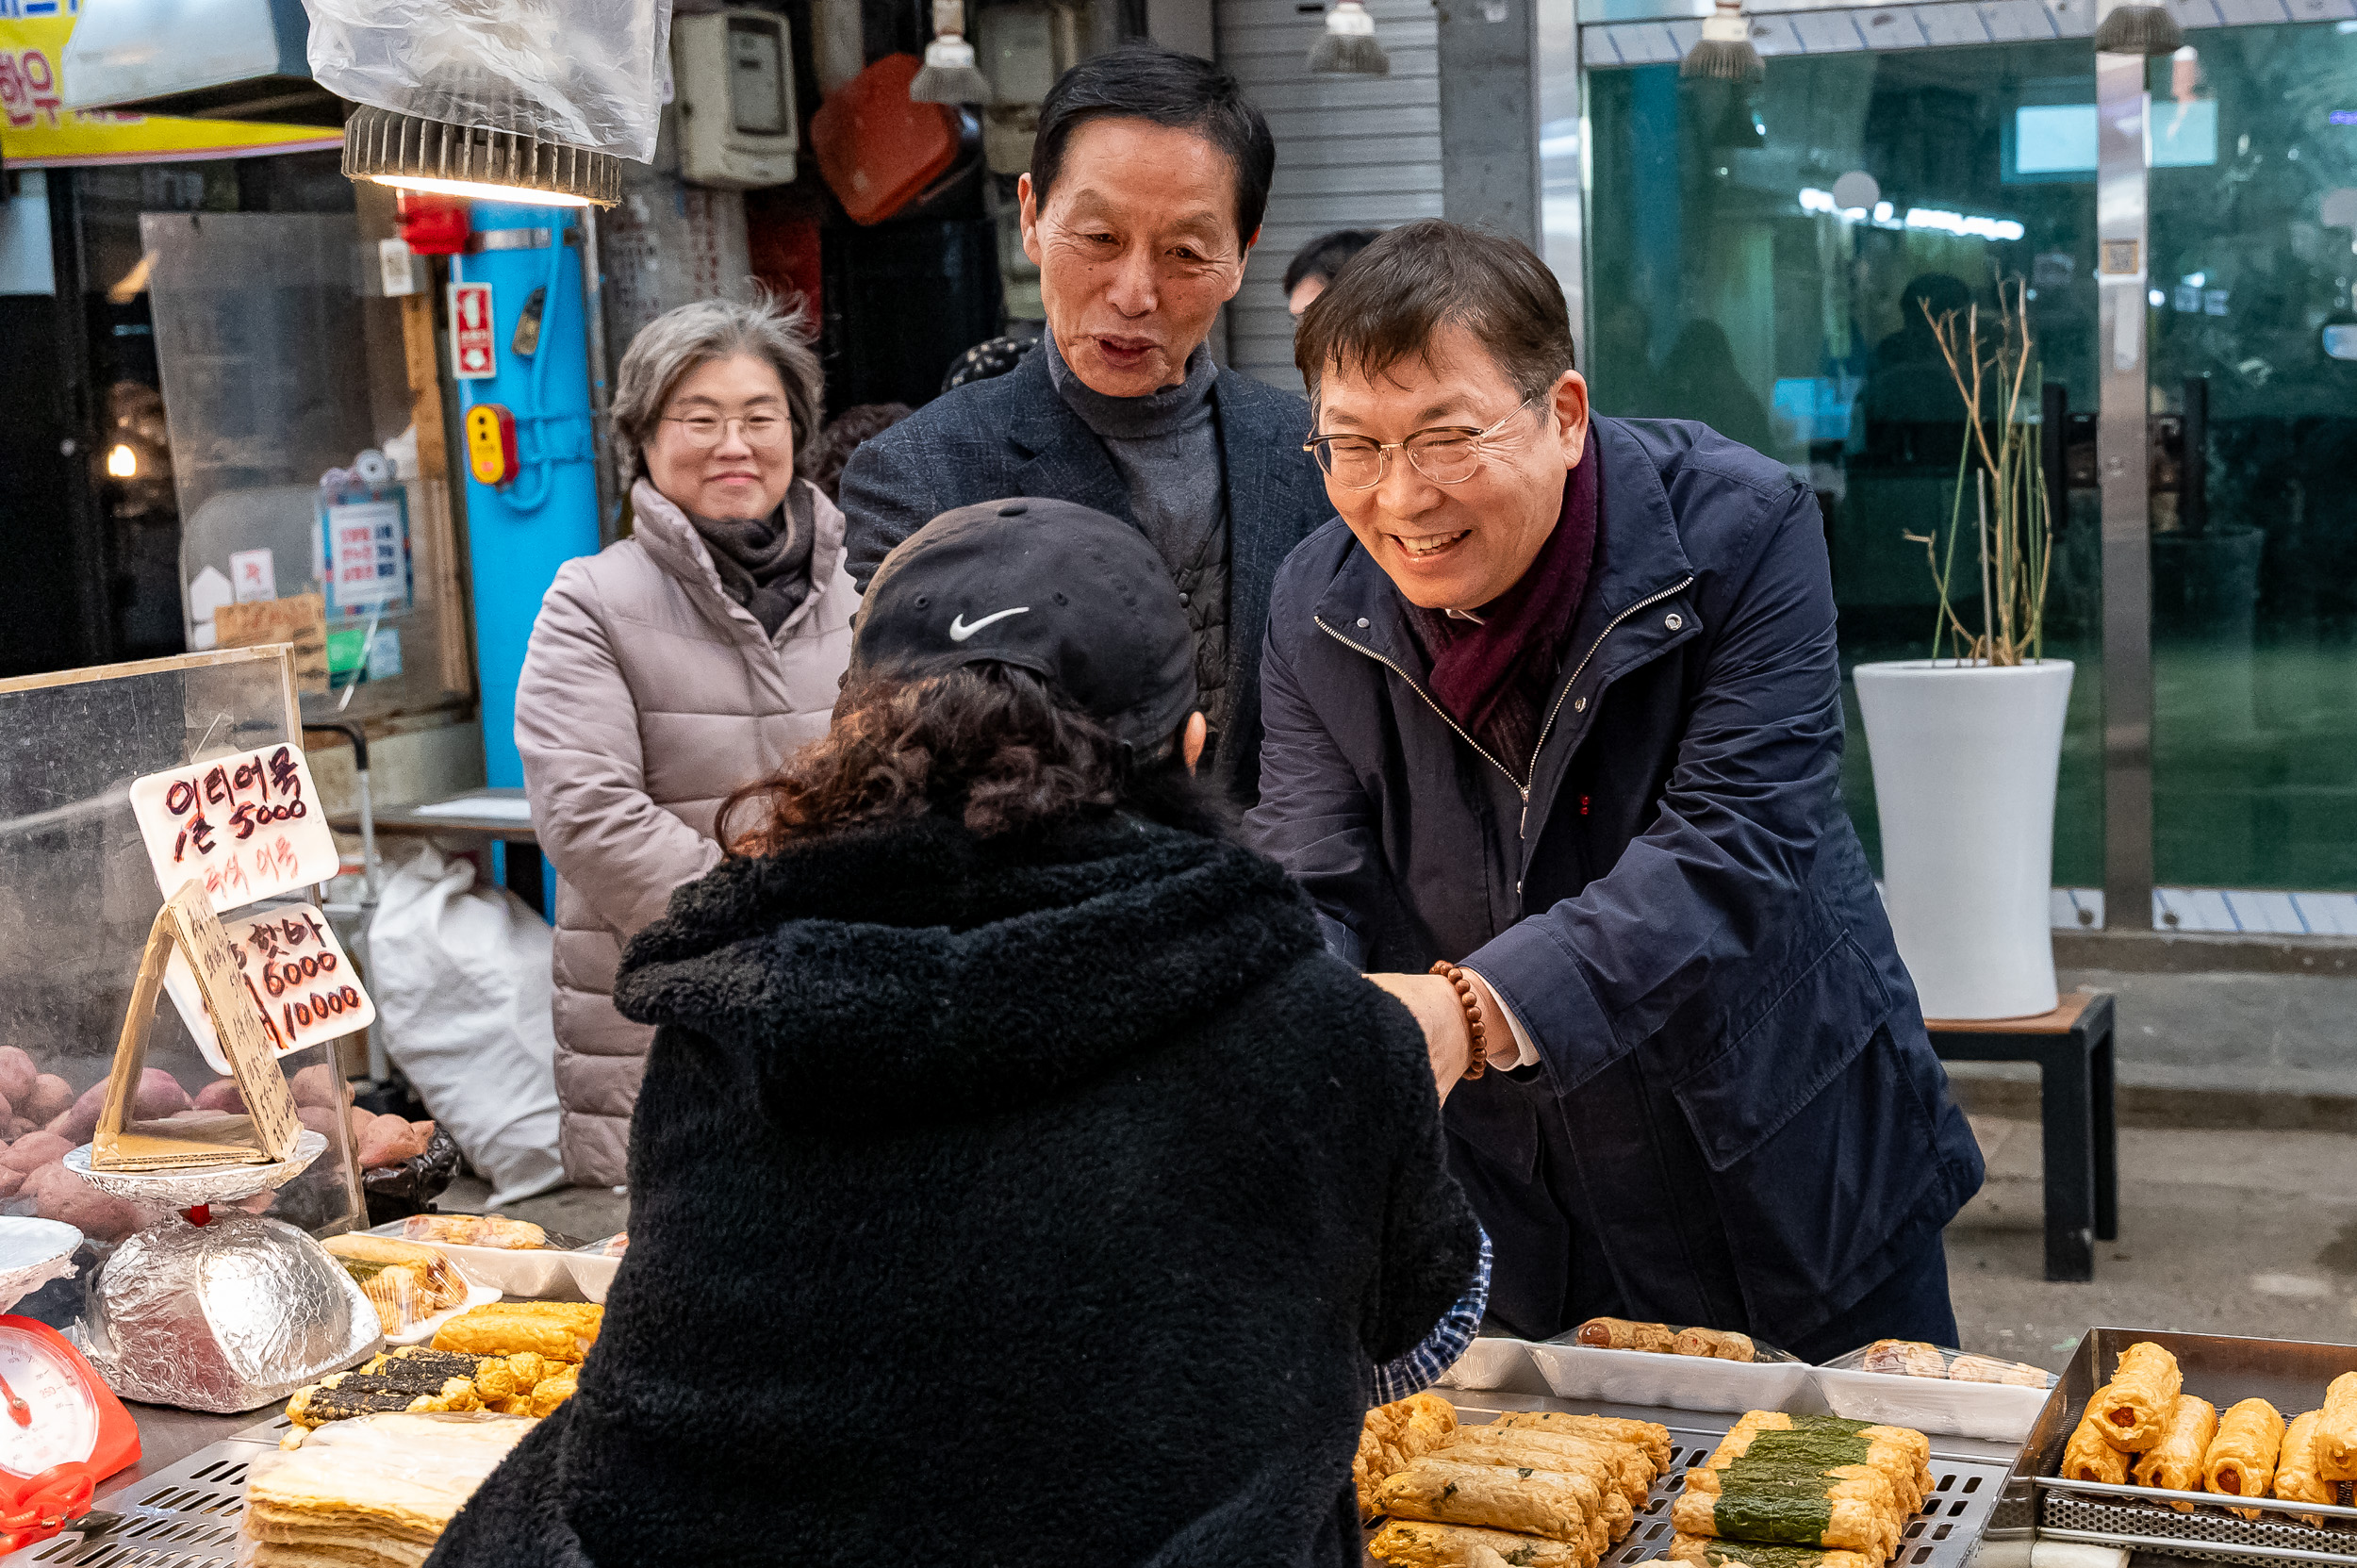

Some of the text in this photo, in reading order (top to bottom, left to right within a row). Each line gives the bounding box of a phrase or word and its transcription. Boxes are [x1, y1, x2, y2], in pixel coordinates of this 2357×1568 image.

[228, 801, 307, 840] 5000
[262, 949, 338, 998] 6000
[283, 984, 360, 1042] 10000
